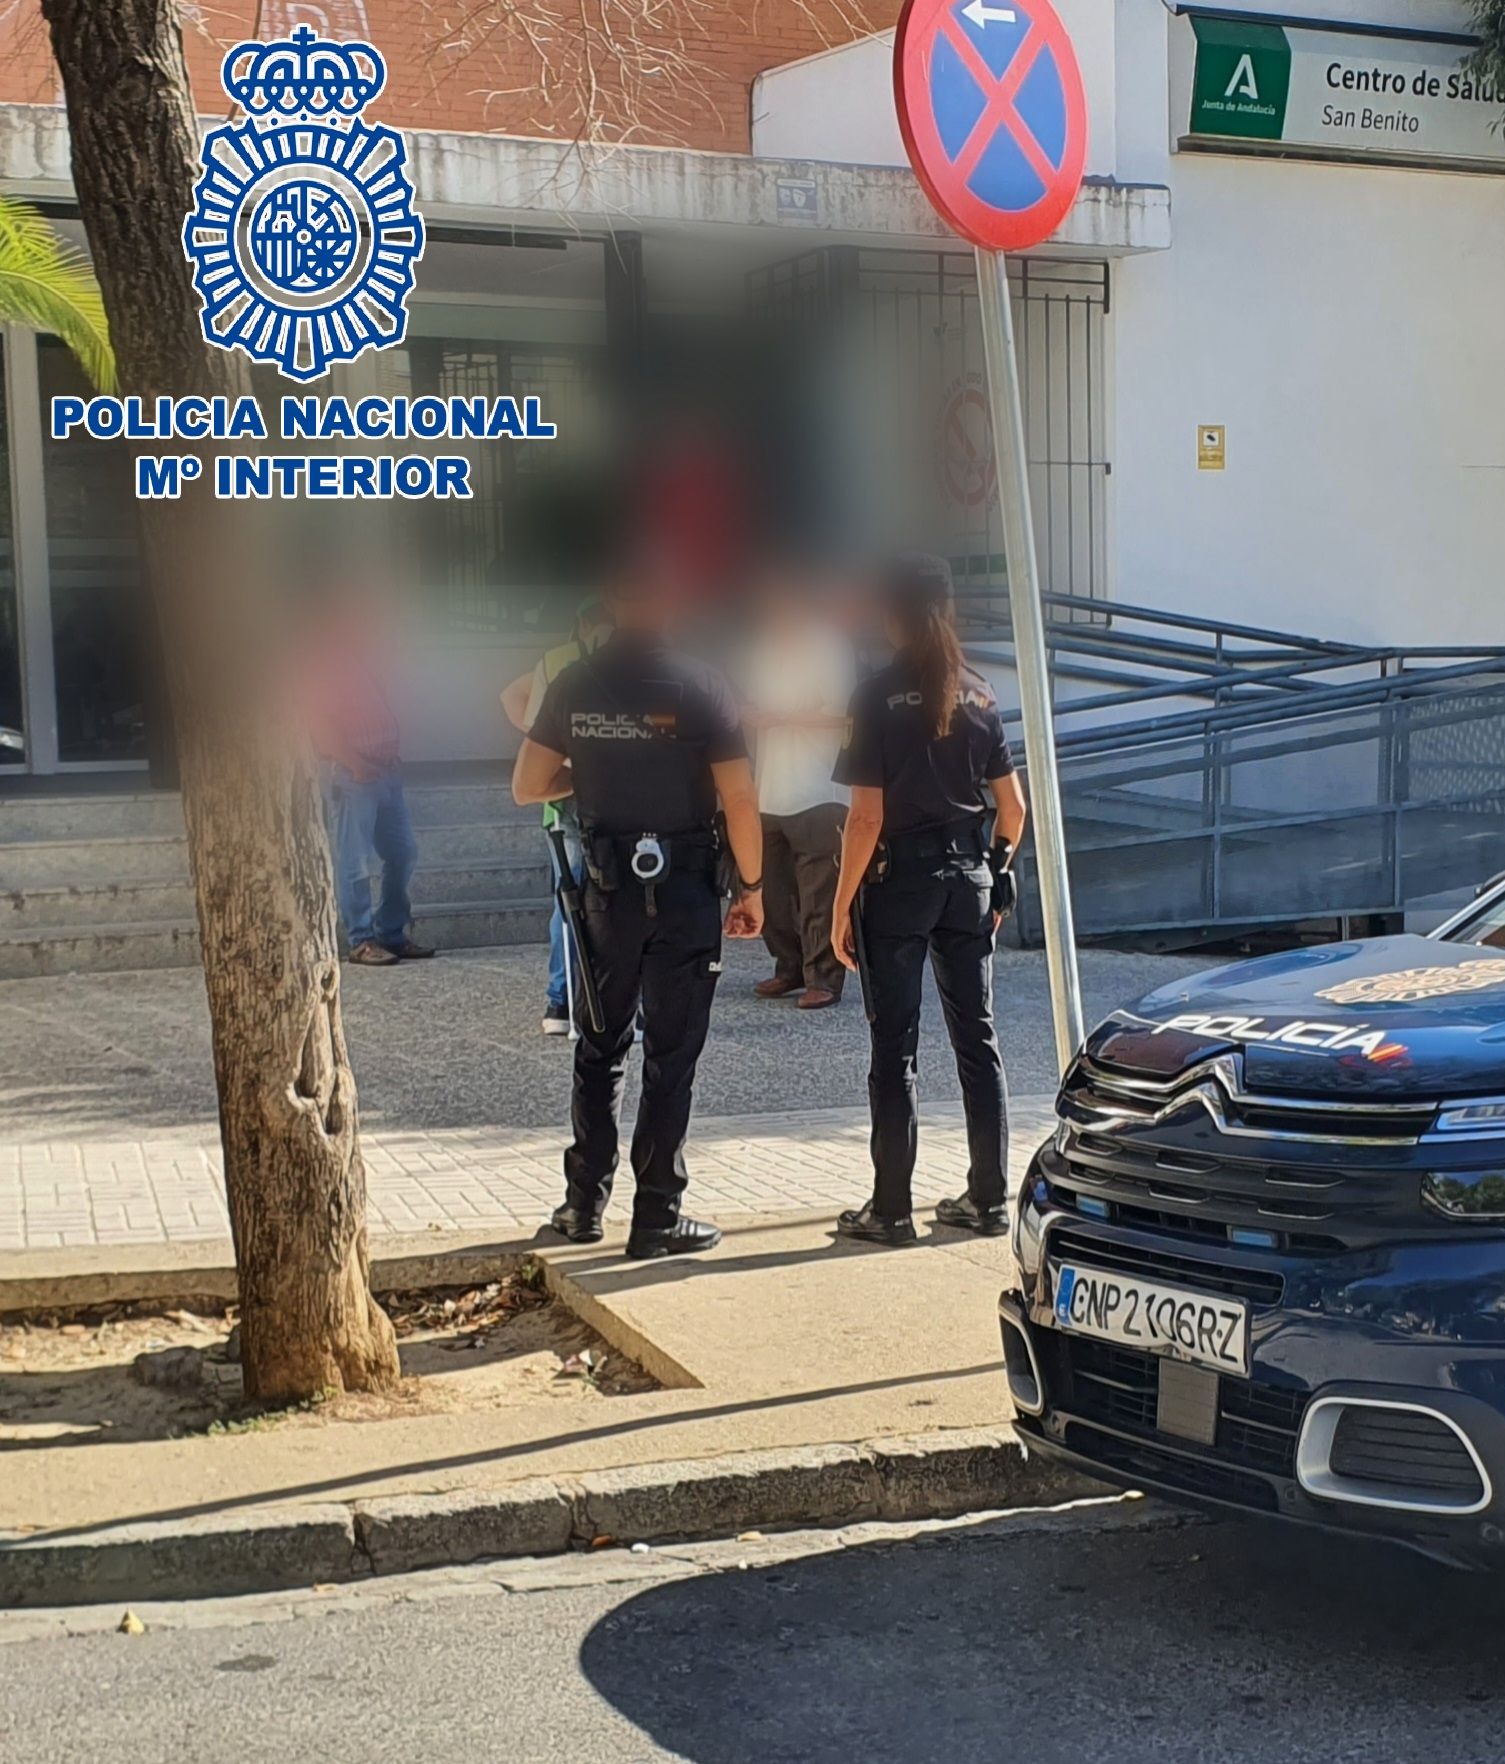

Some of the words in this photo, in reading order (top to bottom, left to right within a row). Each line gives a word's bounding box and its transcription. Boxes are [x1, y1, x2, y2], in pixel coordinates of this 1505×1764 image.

[1326, 62, 1406, 94] Centro
[1412, 69, 1441, 97] de
[1201, 99, 1224, 110] Junta
[1225, 101, 1236, 111] de
[1321, 104, 1356, 128] San
[1360, 108, 1419, 133] Benito
[570, 712, 655, 726] POLICA
[571, 726, 677, 739] NACION
[1151, 1014, 1386, 1056] POLICÍA
